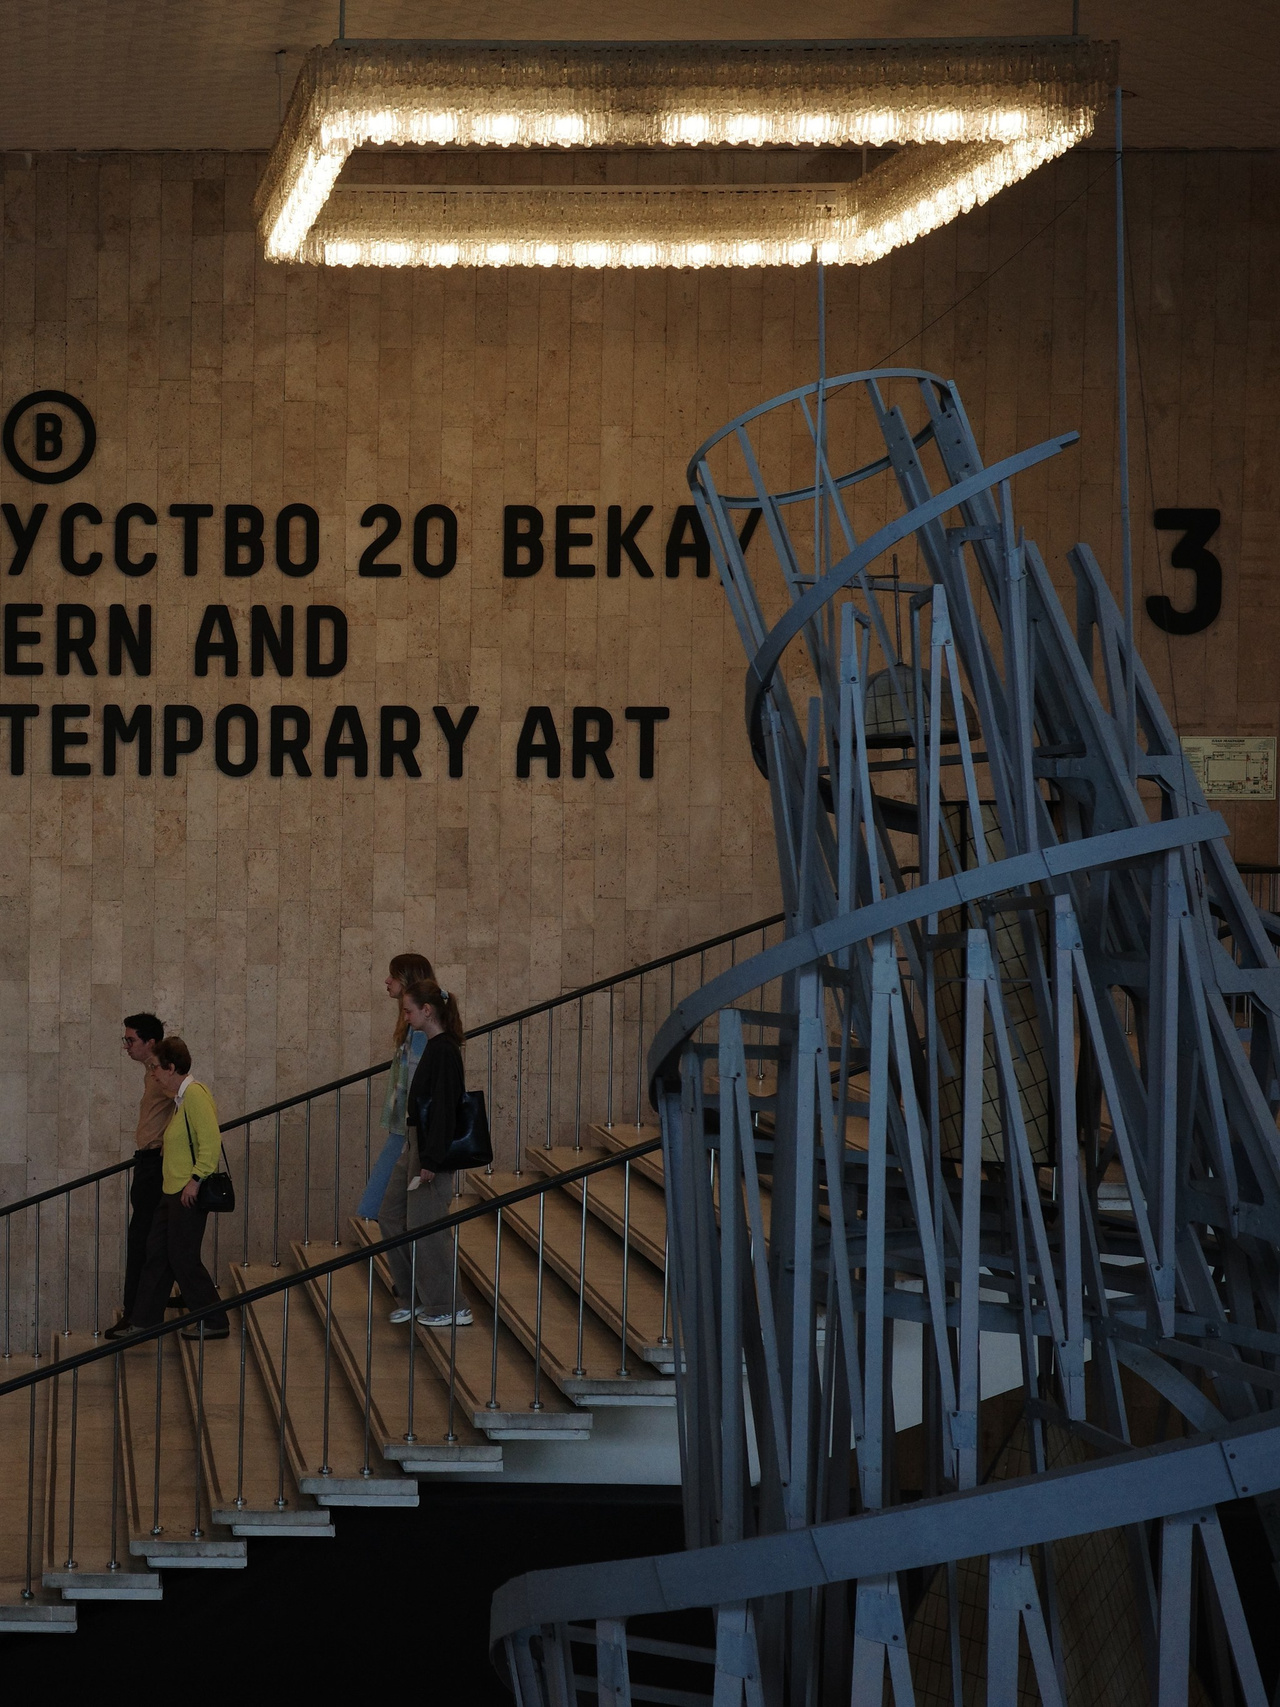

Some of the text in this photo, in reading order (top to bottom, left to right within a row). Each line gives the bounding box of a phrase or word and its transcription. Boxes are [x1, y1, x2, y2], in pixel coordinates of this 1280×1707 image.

[358, 503, 458, 579] 20
[1145, 508, 1222, 635] 3
[194, 604, 348, 678] AND
[516, 705, 670, 779] ART
